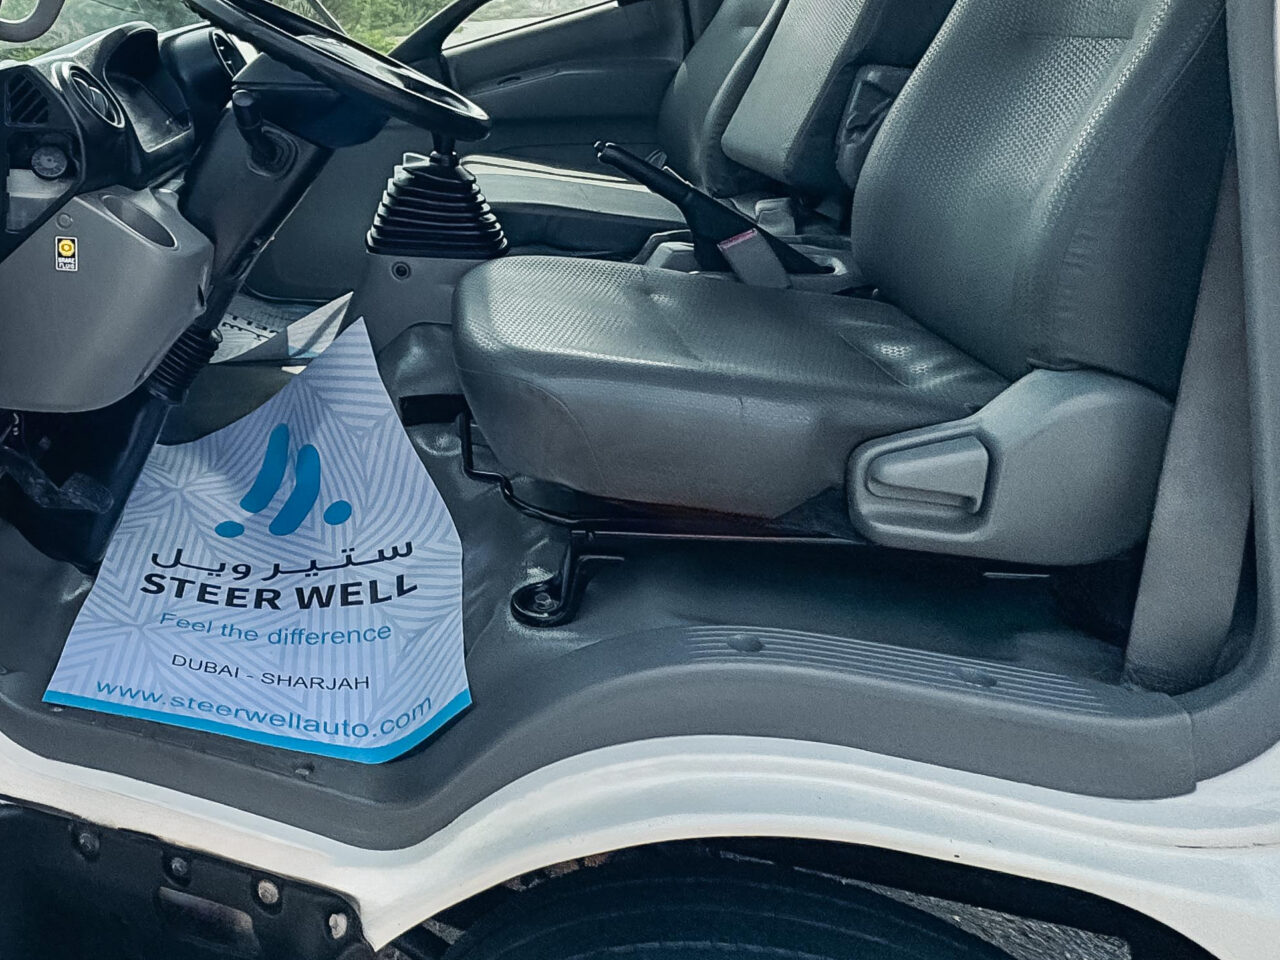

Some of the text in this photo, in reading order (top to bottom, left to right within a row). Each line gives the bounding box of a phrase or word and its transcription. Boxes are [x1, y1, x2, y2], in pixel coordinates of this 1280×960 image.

[140, 572, 418, 611] STEER WELL
[159, 611, 393, 647] Feel the difference
[171, 653, 240, 679] DUBAI
[260, 671, 370, 691] SHARJAH
[96, 680, 433, 739] www.steerwellauto.com
